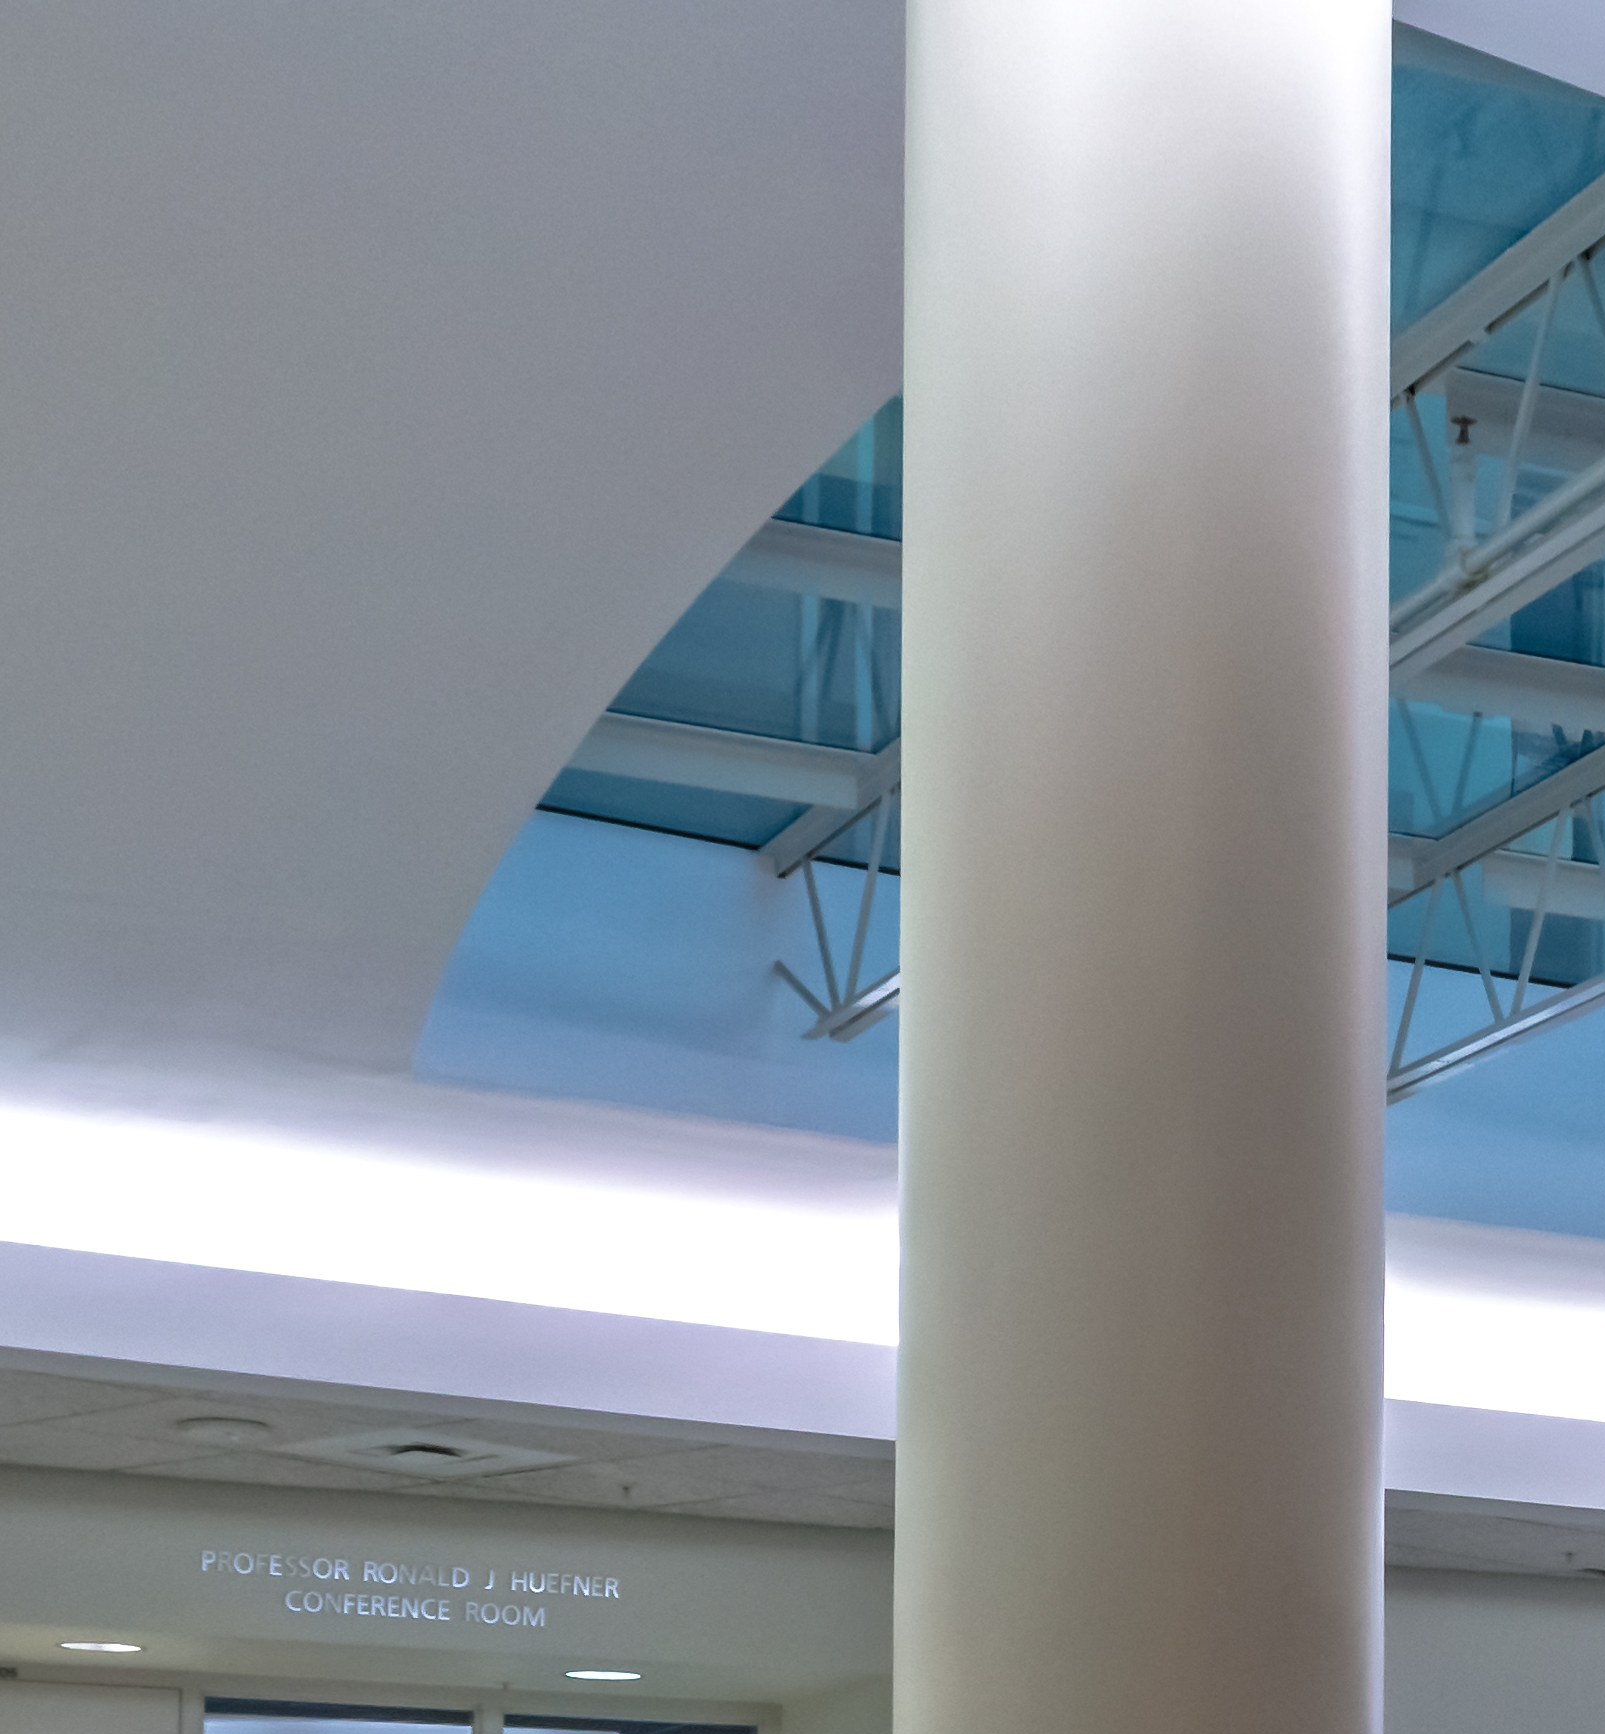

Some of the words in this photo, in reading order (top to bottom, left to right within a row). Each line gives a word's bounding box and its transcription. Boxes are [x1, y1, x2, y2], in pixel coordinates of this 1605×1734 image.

[201, 1550, 350, 1581] PROFESSOR
[363, 1560, 470, 1589] RONALD
[484, 1569, 496, 1590] J
[511, 1570, 620, 1599] HUEFNER
[285, 1590, 451, 1622] CONFERENCE
[465, 1601, 546, 1628] ROOM
